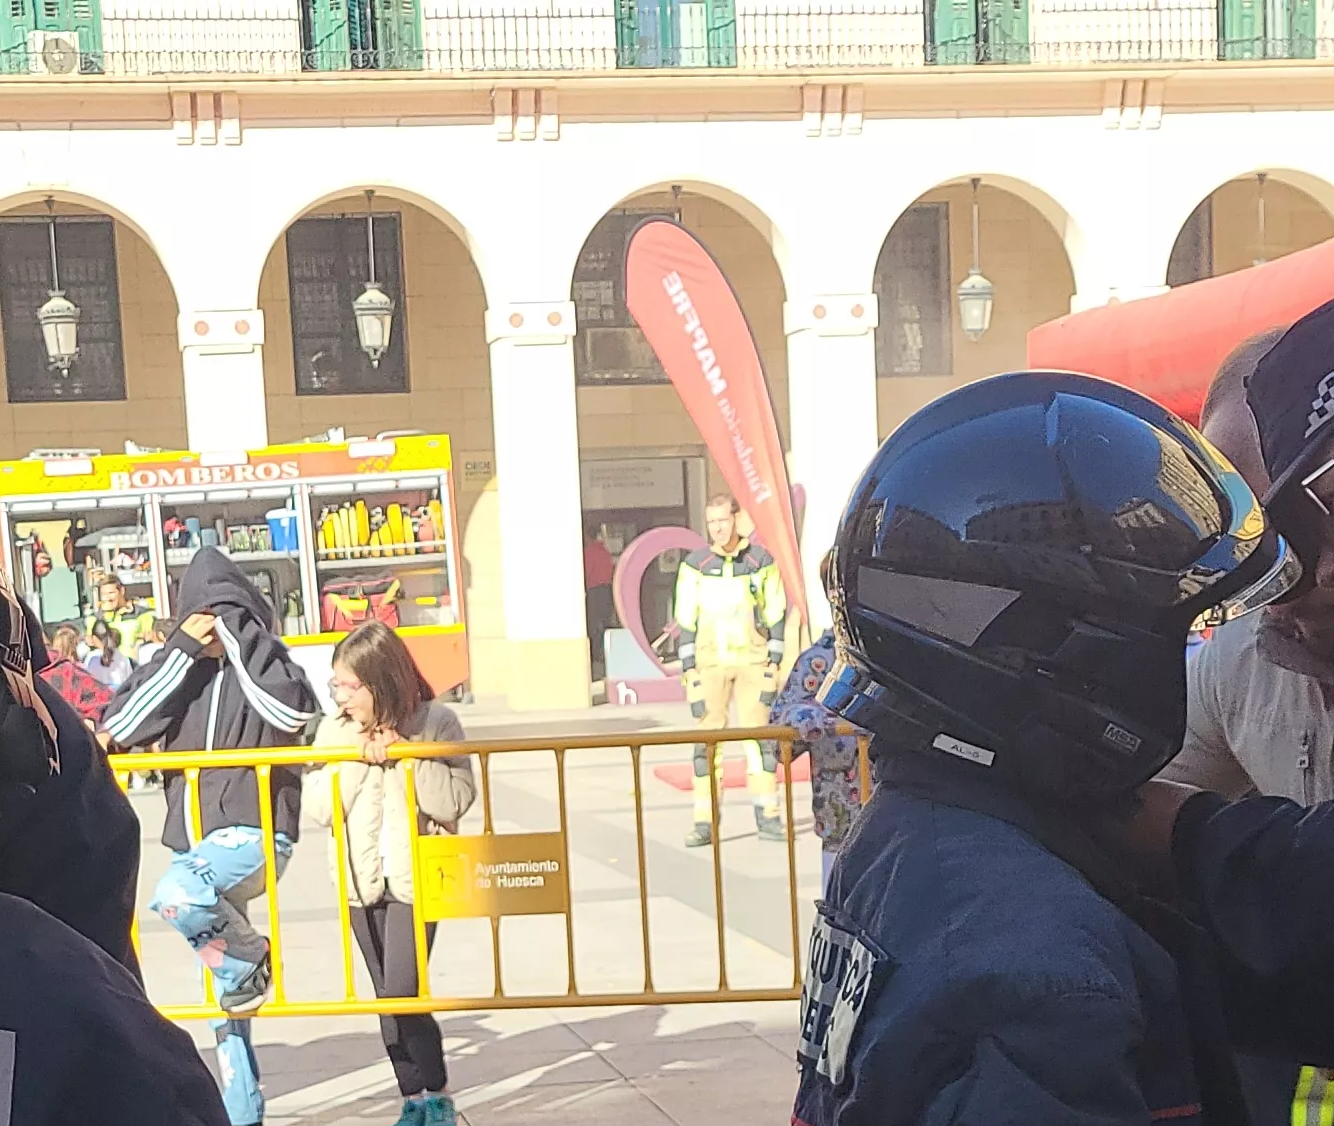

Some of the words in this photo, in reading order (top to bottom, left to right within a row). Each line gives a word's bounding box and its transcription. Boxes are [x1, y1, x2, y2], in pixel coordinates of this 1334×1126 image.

[110, 461, 300, 490] BOMBEROS
[474, 860, 560, 877] Ayuntamiento
[496, 875, 545, 888] Huesca
